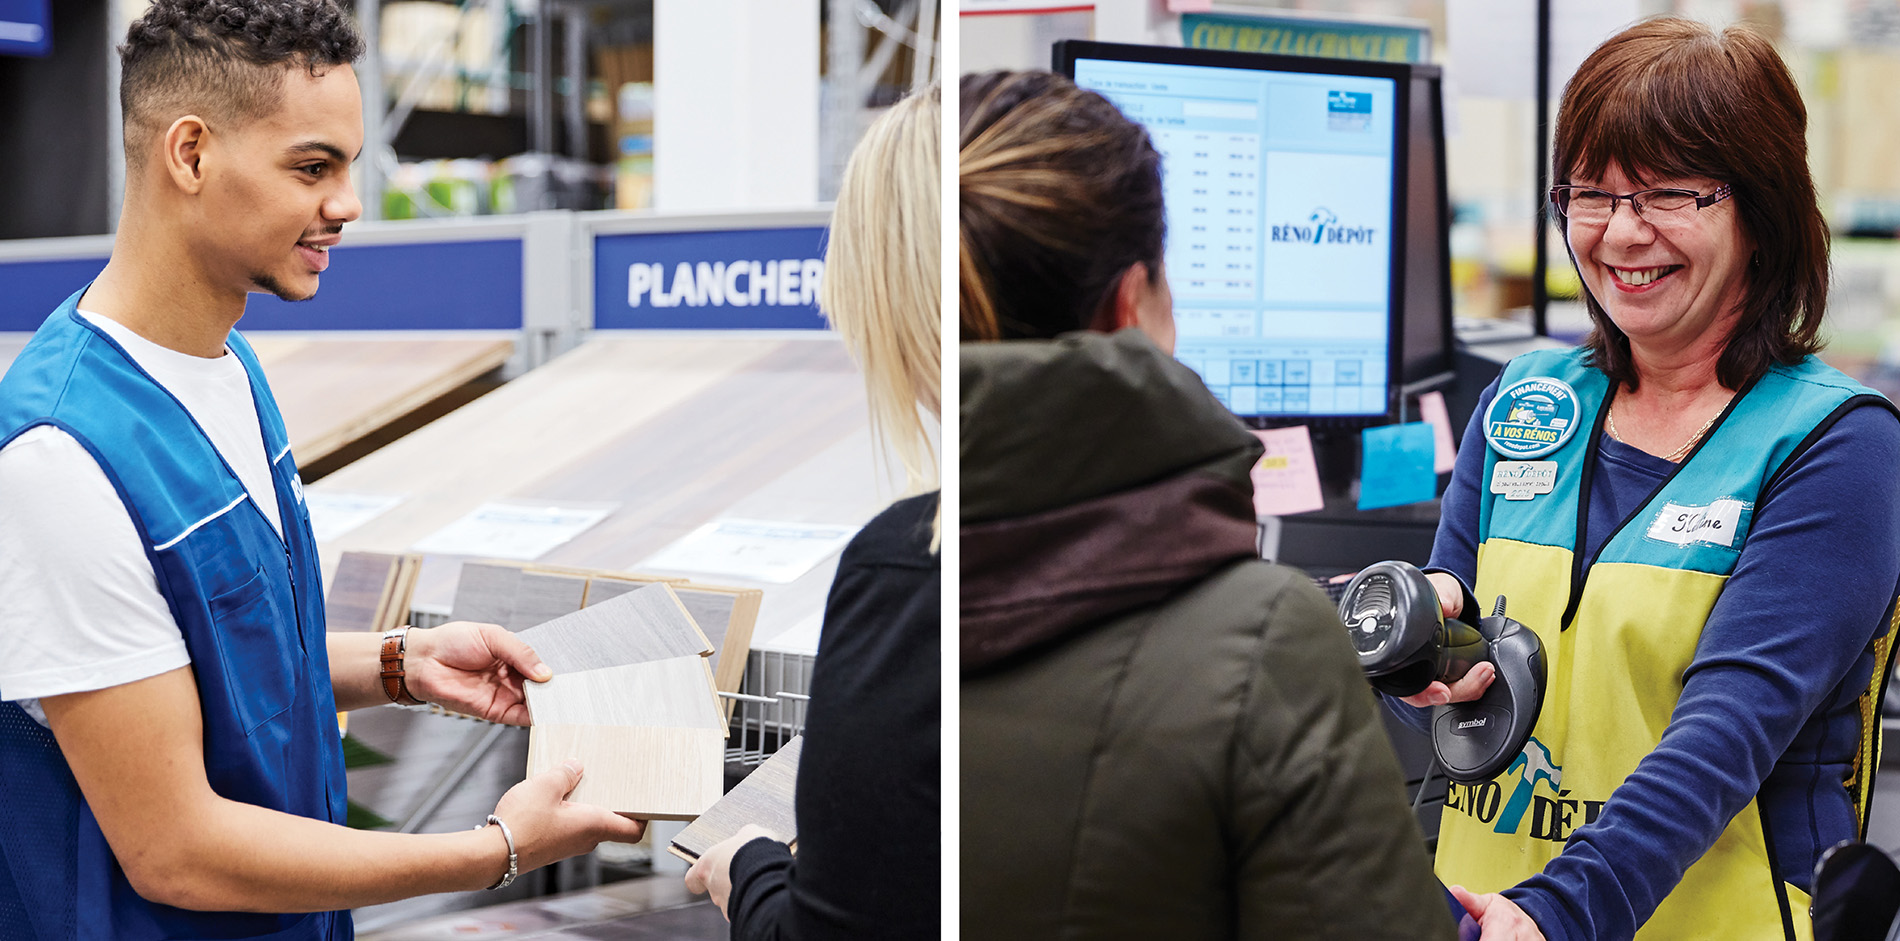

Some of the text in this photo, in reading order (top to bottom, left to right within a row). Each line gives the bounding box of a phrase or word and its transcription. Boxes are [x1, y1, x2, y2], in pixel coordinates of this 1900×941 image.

[1271, 224, 1375, 245] RÉNO DÉPÔT
[628, 258, 827, 308] PLANCHER
[1510, 383, 1567, 400] FINANCEMENT
[1494, 424, 1557, 443] À VOS RÉNOS
[1457, 717, 1487, 730] symbol
